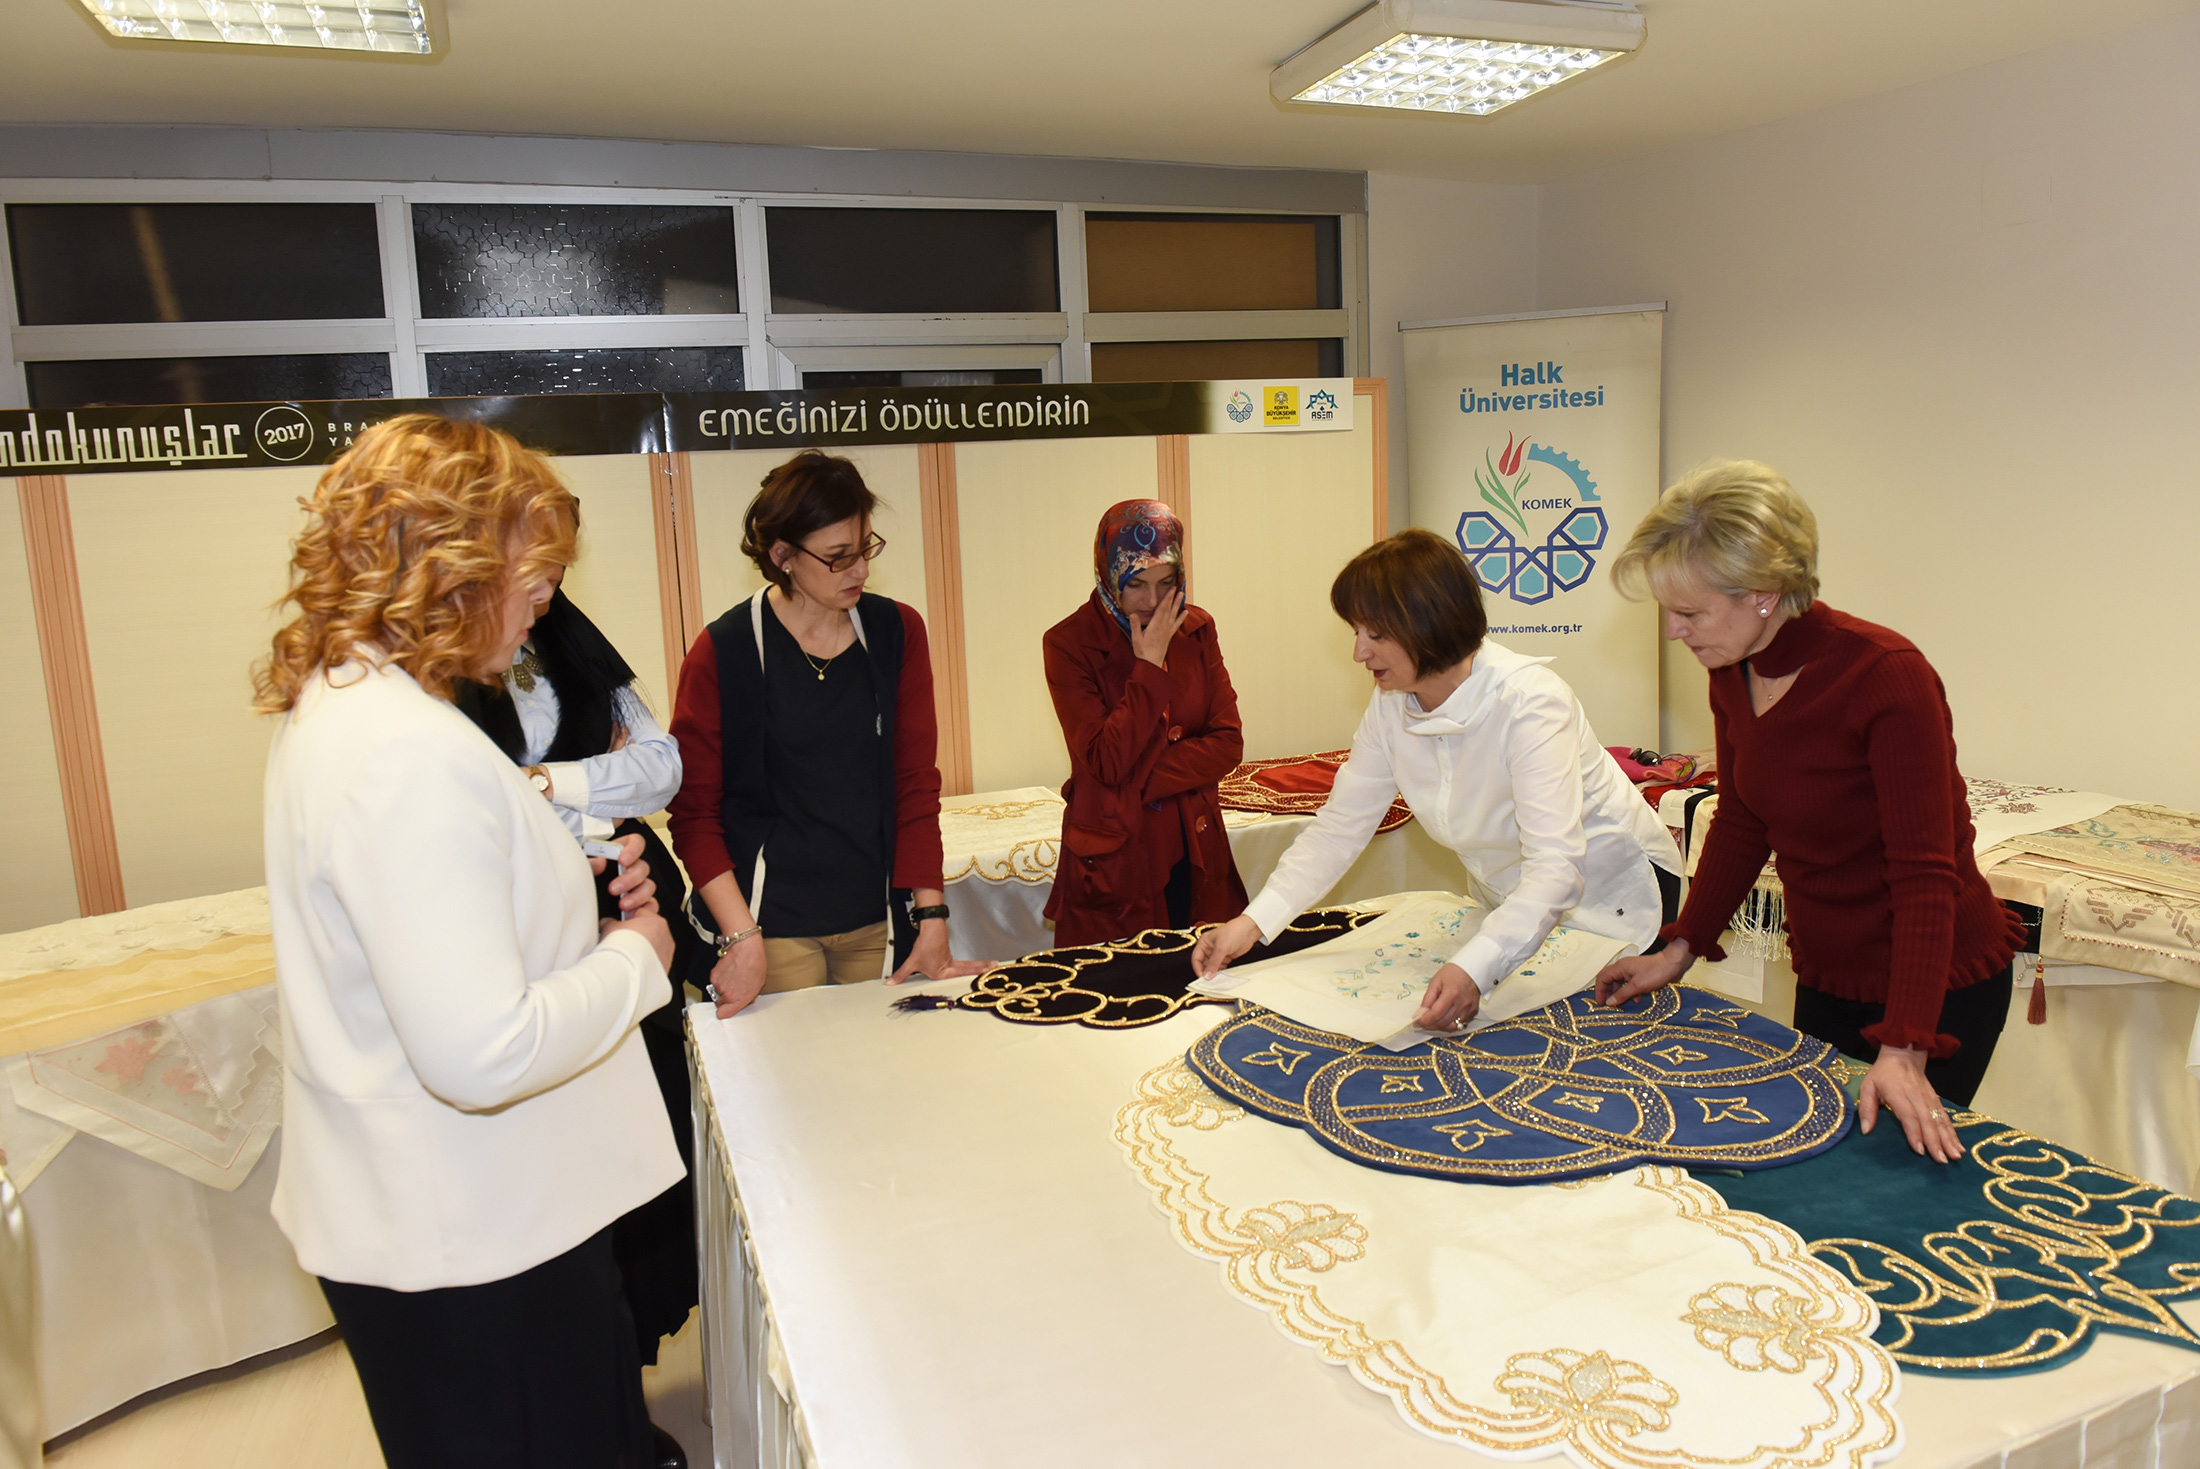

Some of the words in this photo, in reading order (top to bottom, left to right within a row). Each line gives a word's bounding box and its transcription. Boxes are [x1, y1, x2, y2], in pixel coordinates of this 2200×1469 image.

[1501, 361, 1563, 387] Halk
[1459, 385, 1605, 413] Üniversitesi
[264, 422, 305, 445] 2017
[1521, 497, 1573, 511] KOMEK
